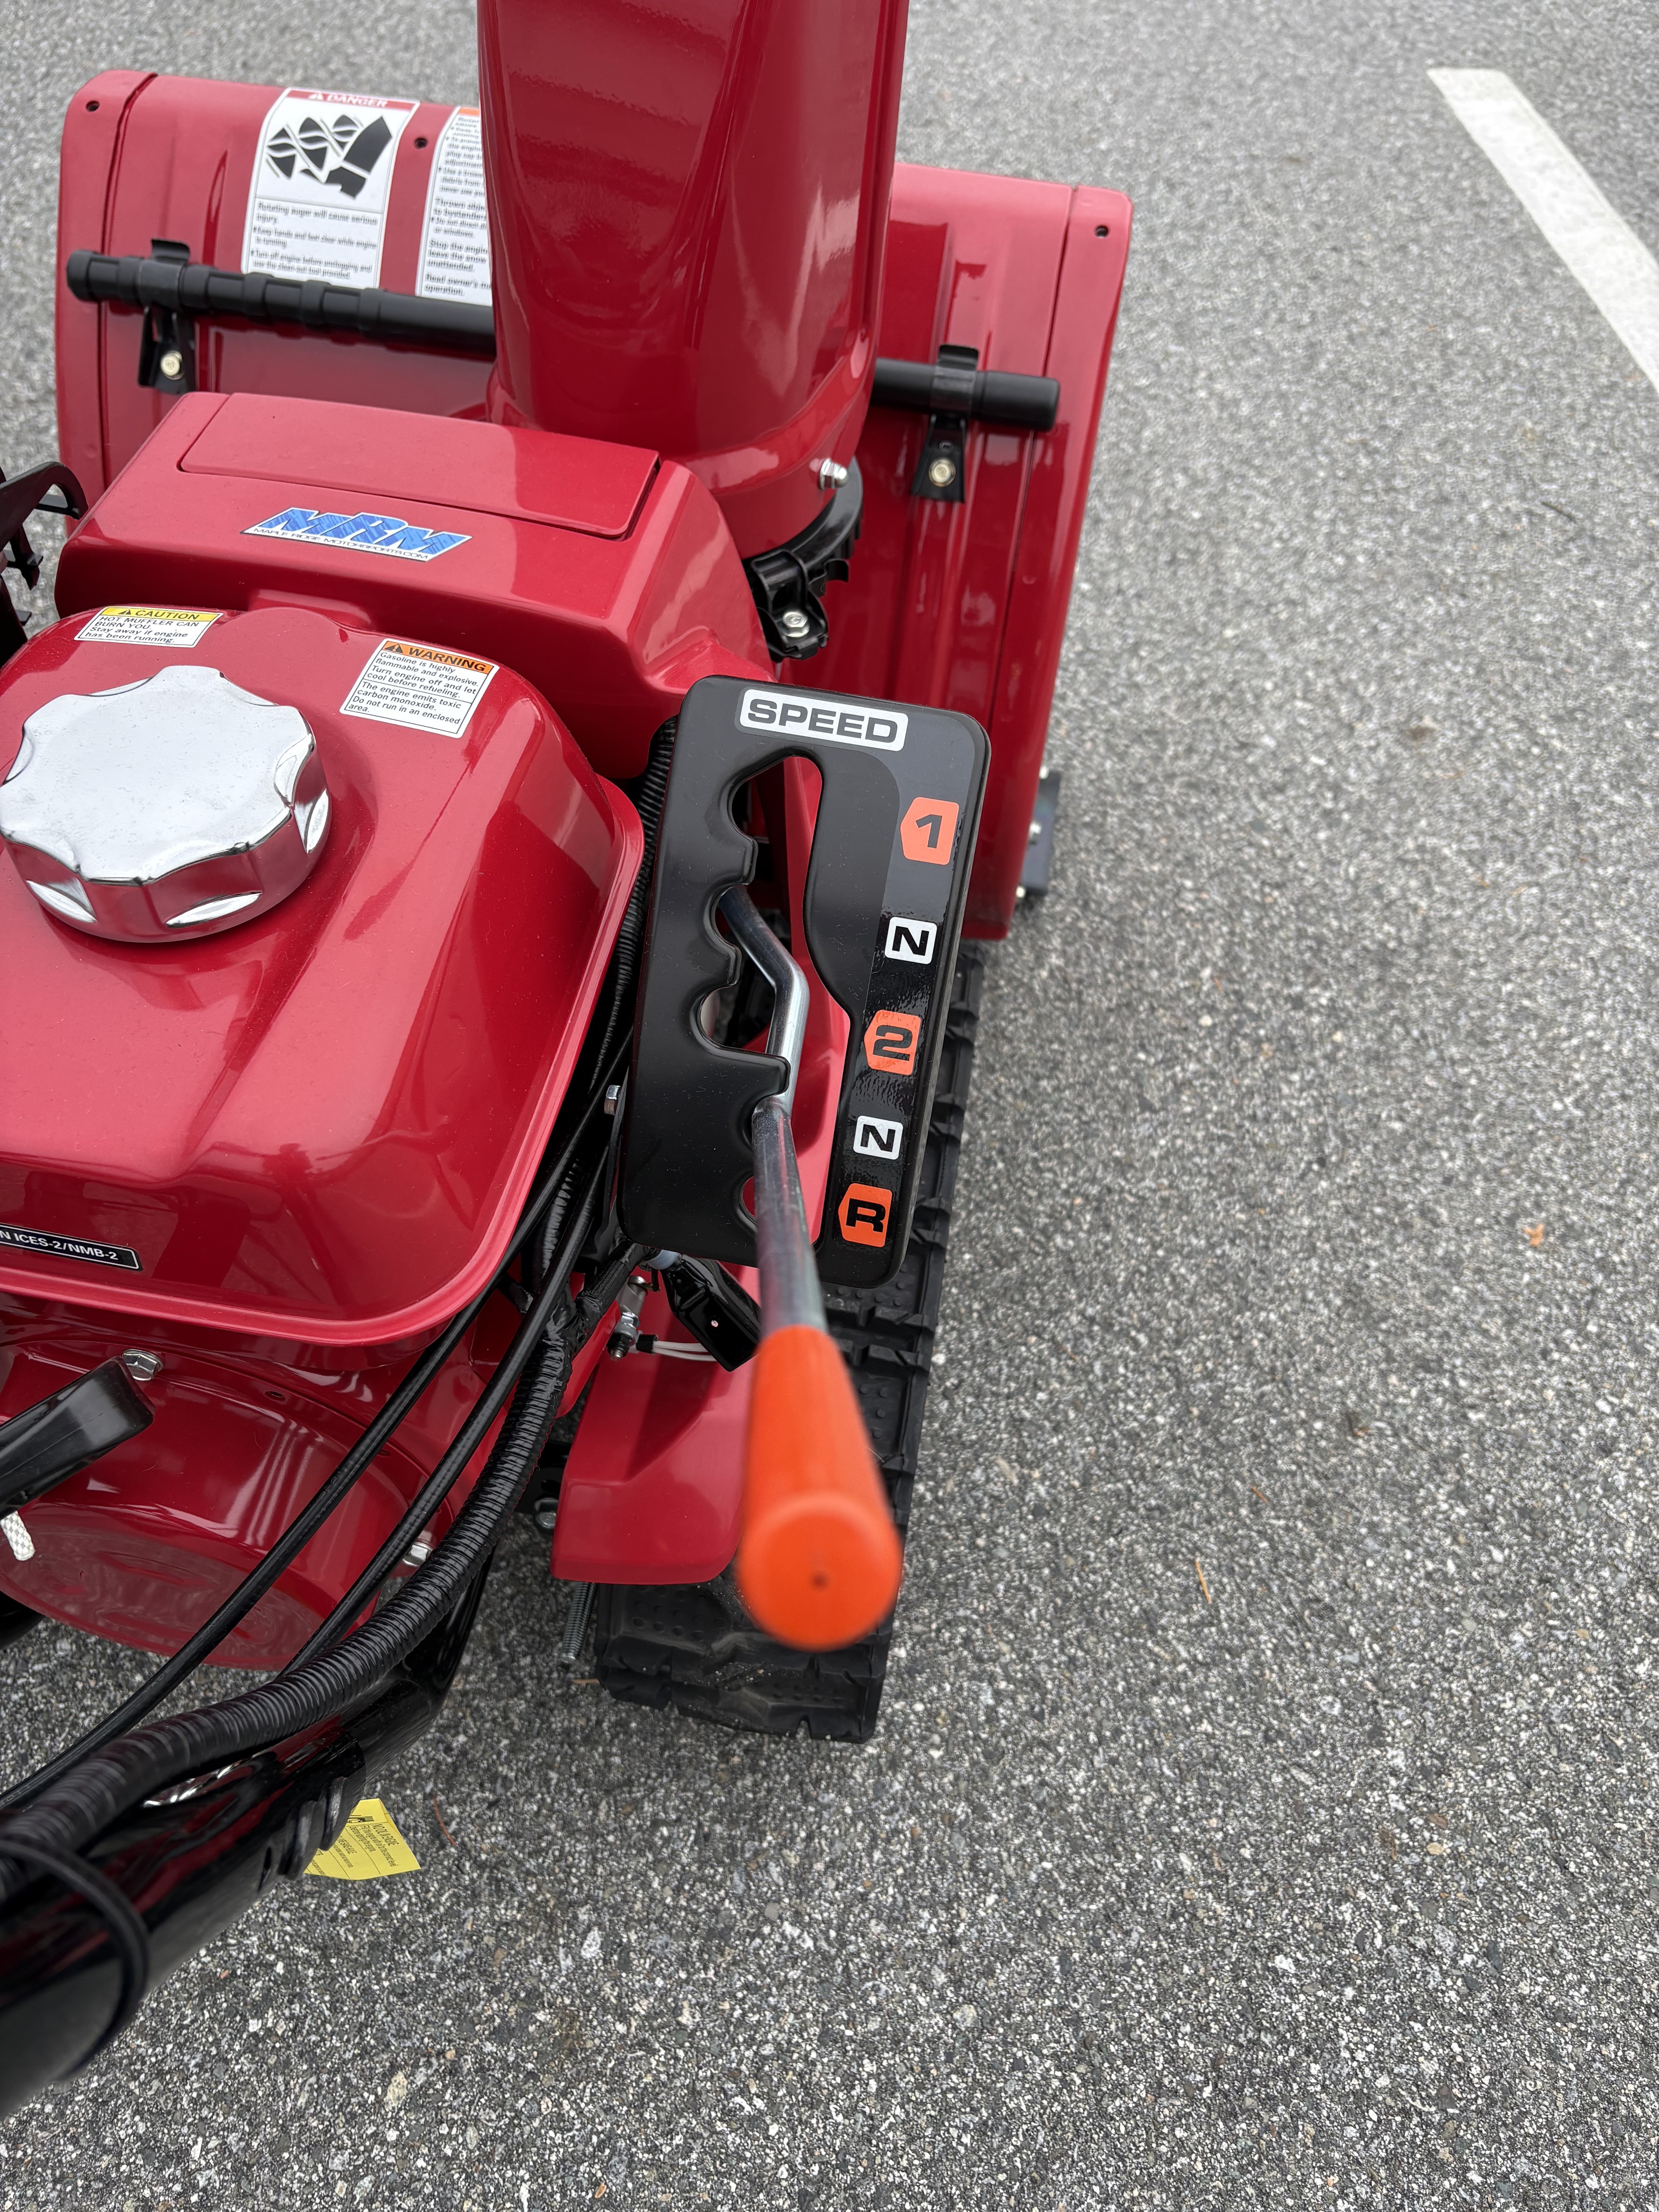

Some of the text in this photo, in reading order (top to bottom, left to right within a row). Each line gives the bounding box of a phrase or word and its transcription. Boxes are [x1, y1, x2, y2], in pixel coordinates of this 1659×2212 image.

[327, 94, 388, 108] DANGER
[435, 197, 465, 208] Thrown
[428, 248, 449, 258] leave
[450, 251, 464, 261] the
[429, 239, 448, 250] Stop
[450, 242, 464, 251] the
[426, 259, 475, 272] unattended.
[425, 272, 446, 283] Read
[424, 283, 465, 296] operation.
[258, 508, 469, 555] MRM
[254, 527, 428, 560] MAPLE RIDGE MOTORSPORTS.COM
[125, 618, 173, 626] MUFFLER
[135, 610, 200, 620] CAUTION
[380, 652, 417, 665] Gasoline
[429, 663, 456, 674] highly
[409, 647, 486, 672] WARNING
[372, 665, 392, 675] Turn
[394, 671, 426, 683] engine
[443, 682, 462, 691] and
[464, 686, 476, 695] let
[376, 658, 479, 687] flammable and explosive.
[361, 681, 462, 709] The engine emits toxic
[388, 677, 417, 688] before
[419, 684, 460, 698] refueling.
[348, 704, 370, 713] area.
[357, 690, 437, 711] carbon monoxide.
[422, 711, 461, 725] enclosed
[748, 699, 898, 743] SPEED
[915, 814, 943, 849] 1
[892, 927, 929, 956] N
[872, 1025, 912, 1061] 2
[859, 1125, 896, 1152] N
[846, 1199, 887, 1233] R
[14, 1233, 118, 1261] ICES-2/NMB-2
